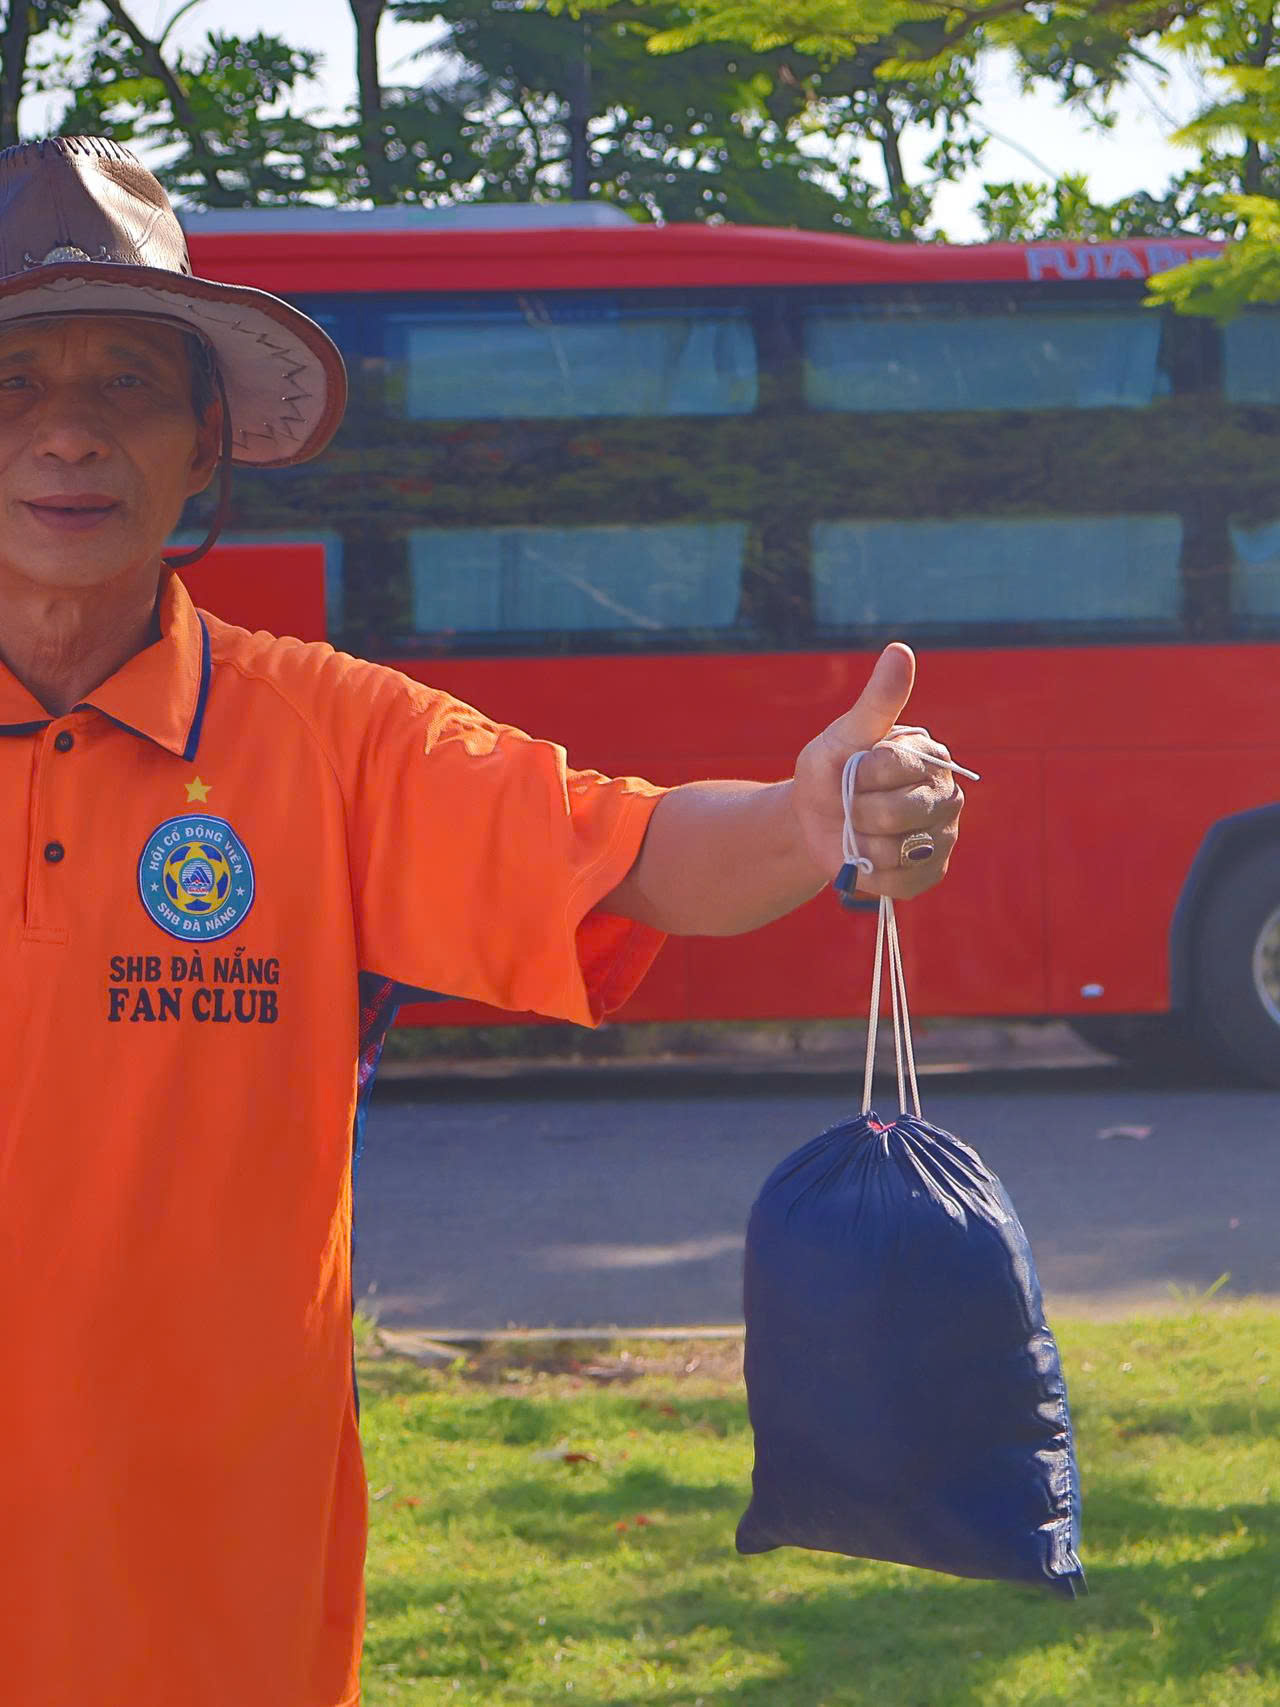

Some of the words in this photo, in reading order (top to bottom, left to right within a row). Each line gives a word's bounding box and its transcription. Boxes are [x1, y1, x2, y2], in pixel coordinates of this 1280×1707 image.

[1025, 246, 1146, 281] FUTA
[149, 846, 165, 871] HỘI
[184, 824, 223, 842] ĐỘNG
[224, 841, 244, 875] VIÊN
[157, 902, 181, 926] SHB
[182, 919, 201, 932] ĐÀ
[109, 956, 162, 983] SHB
[171, 950, 204, 983] ĐÀ
[213, 946, 280, 985] NẴNG
[107, 987, 183, 1023] FAN
[191, 988, 279, 1024] CLUB
